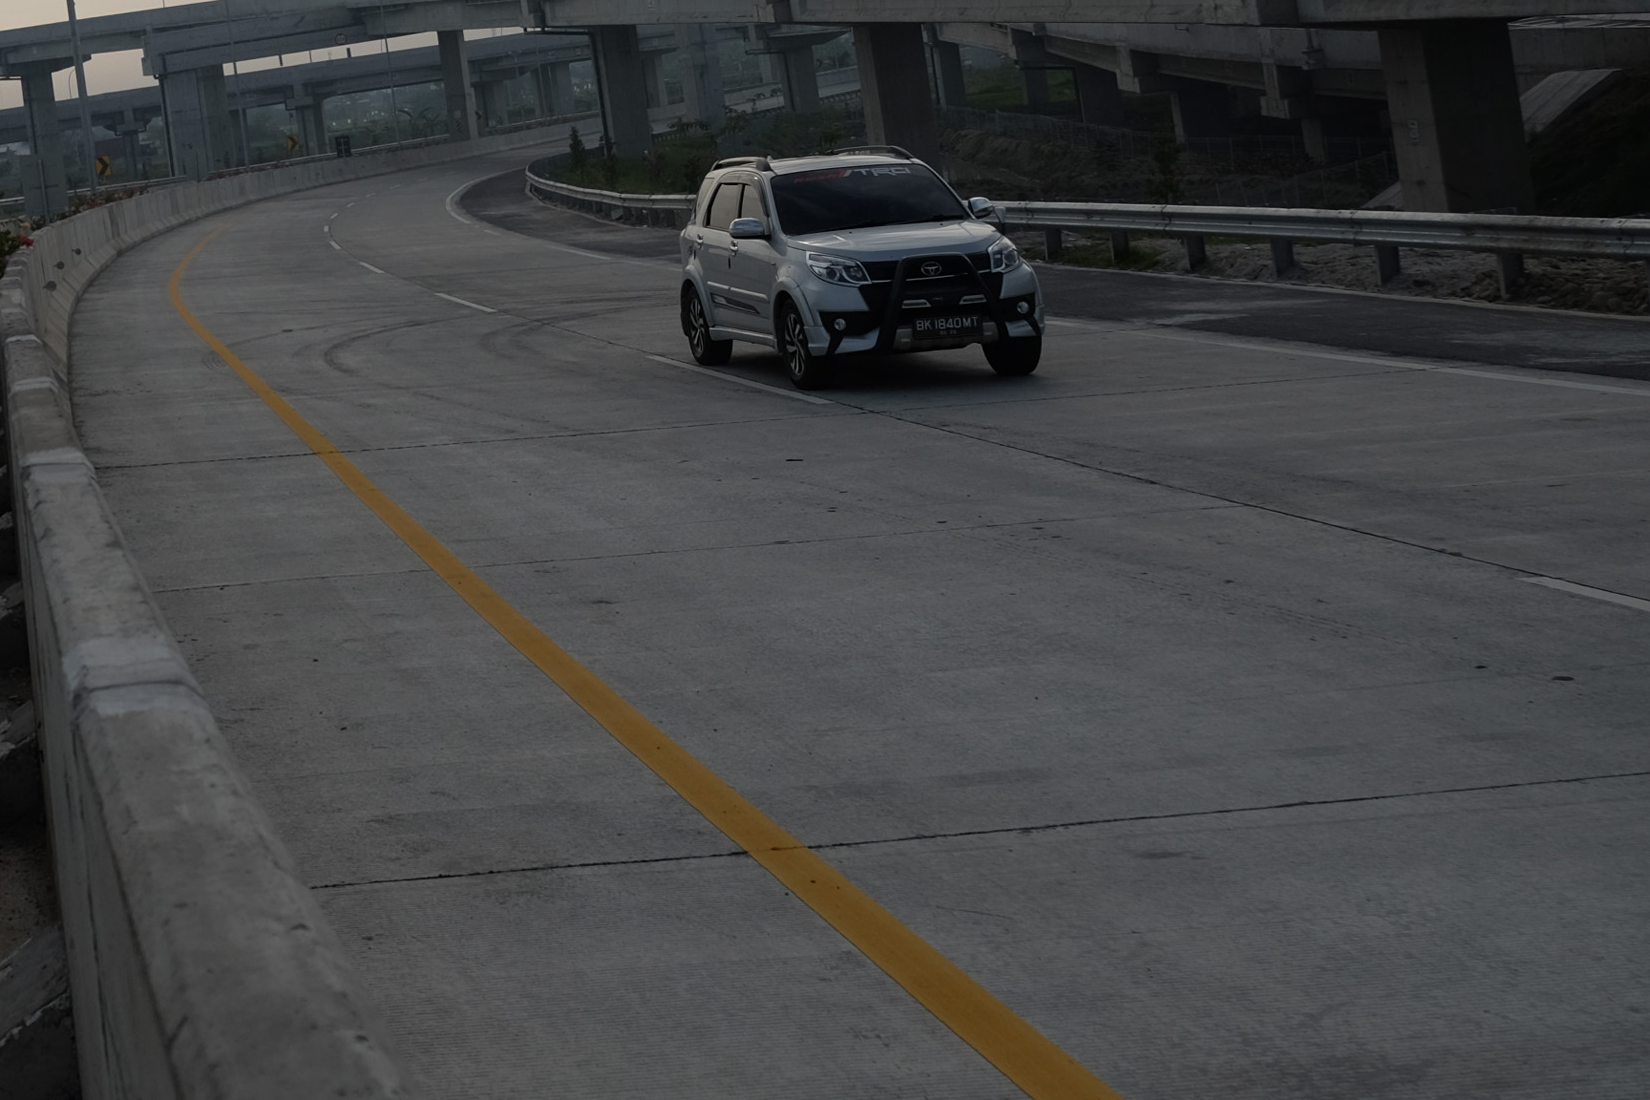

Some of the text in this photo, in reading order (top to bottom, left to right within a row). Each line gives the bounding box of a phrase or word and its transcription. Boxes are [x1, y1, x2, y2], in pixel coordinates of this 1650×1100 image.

[916, 316, 979, 331] BK 1840 MT
